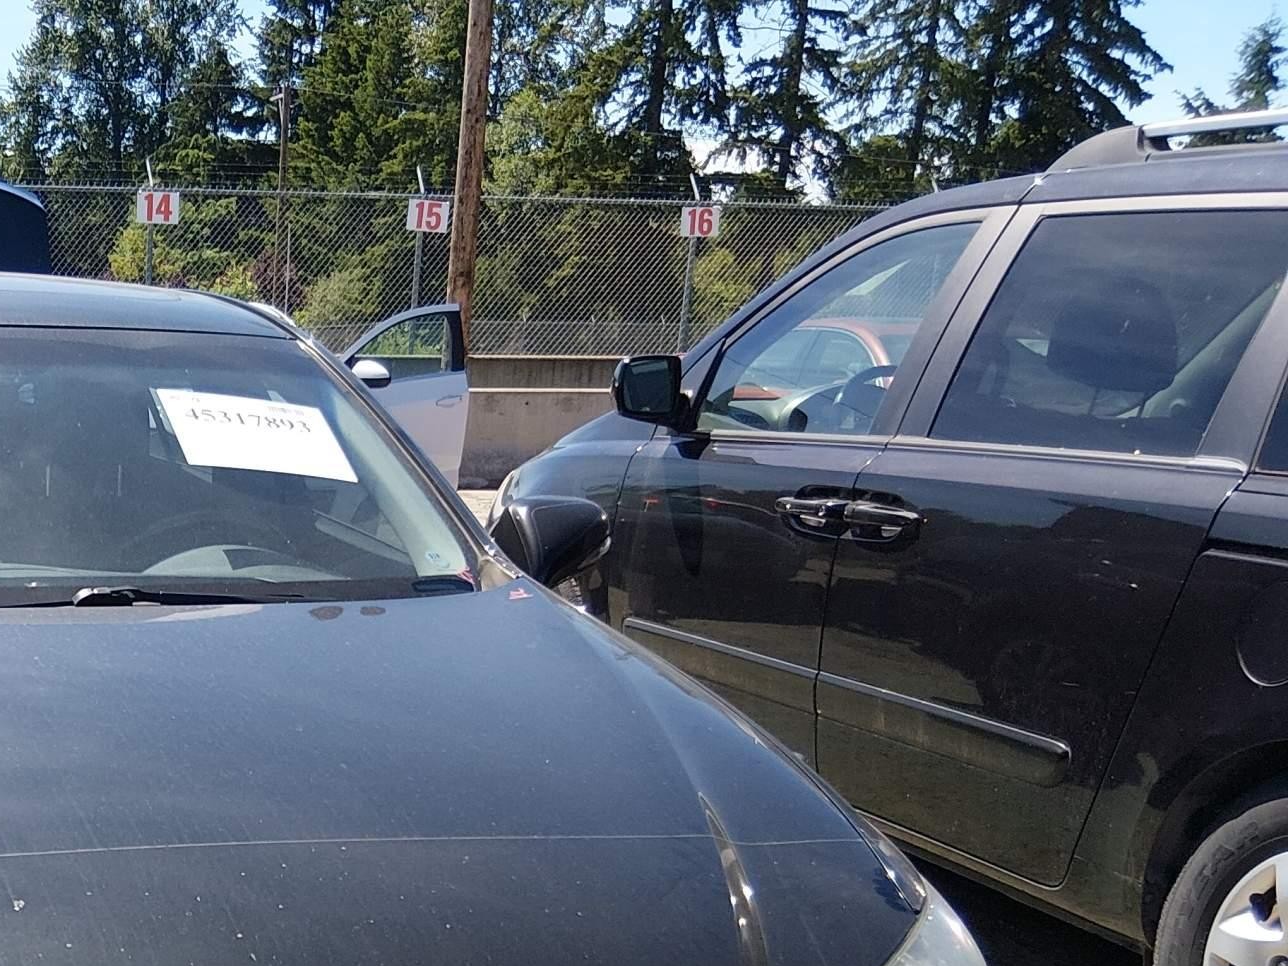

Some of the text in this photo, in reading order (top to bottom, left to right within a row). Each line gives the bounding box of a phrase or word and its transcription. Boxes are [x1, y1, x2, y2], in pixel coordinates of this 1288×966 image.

[143, 193, 173, 222] 14
[415, 201, 442, 231] 15
[688, 208, 713, 236] 16
[185, 407, 312, 433] 45317893
